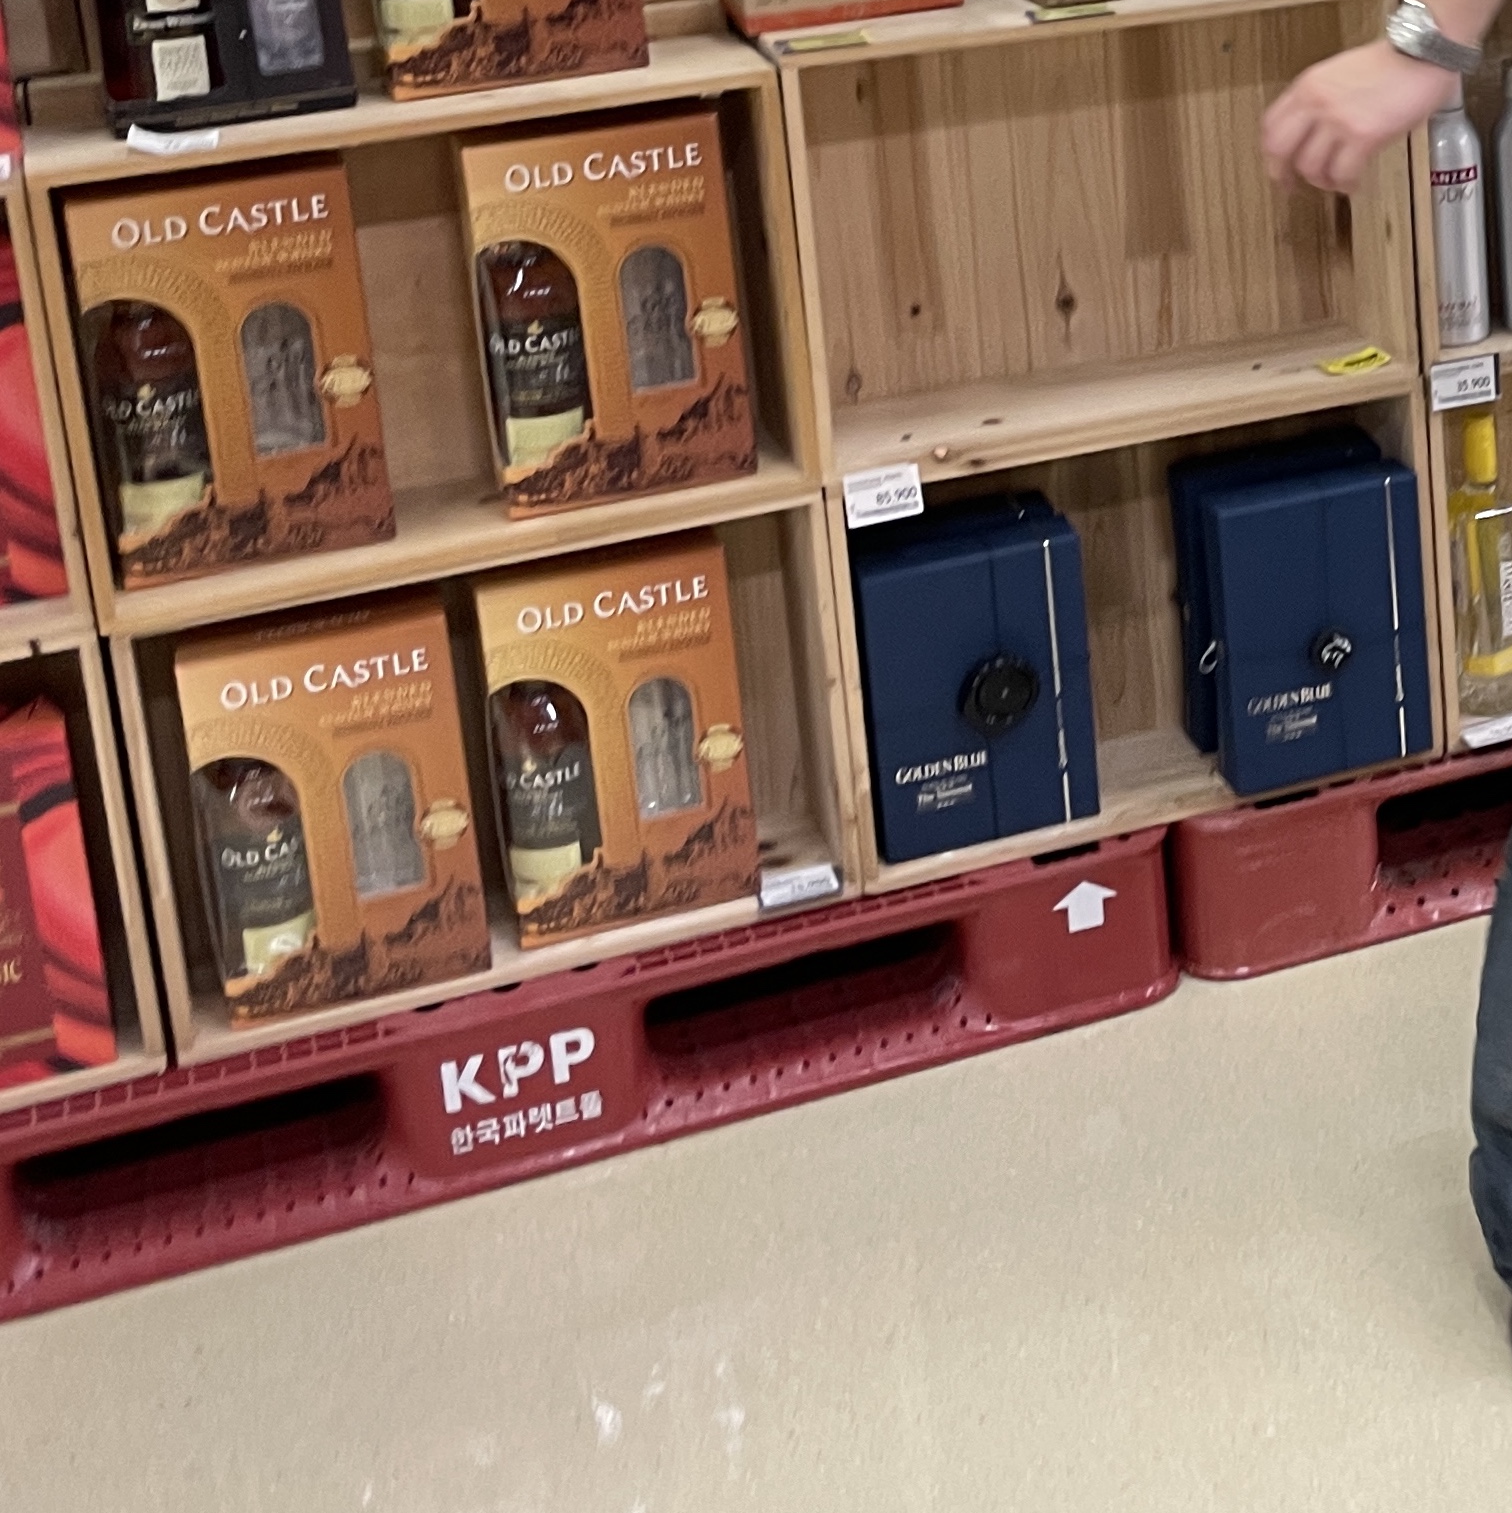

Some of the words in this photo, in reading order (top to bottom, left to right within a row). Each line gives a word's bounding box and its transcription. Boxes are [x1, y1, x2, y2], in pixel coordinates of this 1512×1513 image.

[505, 162, 574, 193] OLD
[583, 142, 703, 181] CASTLE
[111, 214, 188, 251] OLD
[198, 193, 330, 237] CASTLE
[517, 601, 584, 636] OLD
[593, 575, 709, 619] CASTLE
[220, 675, 293, 711] OLD
[303, 647, 429, 693] CASTLE
[895, 755, 953, 785] GOLDEN
[440, 1027, 596, 1114] KPP
